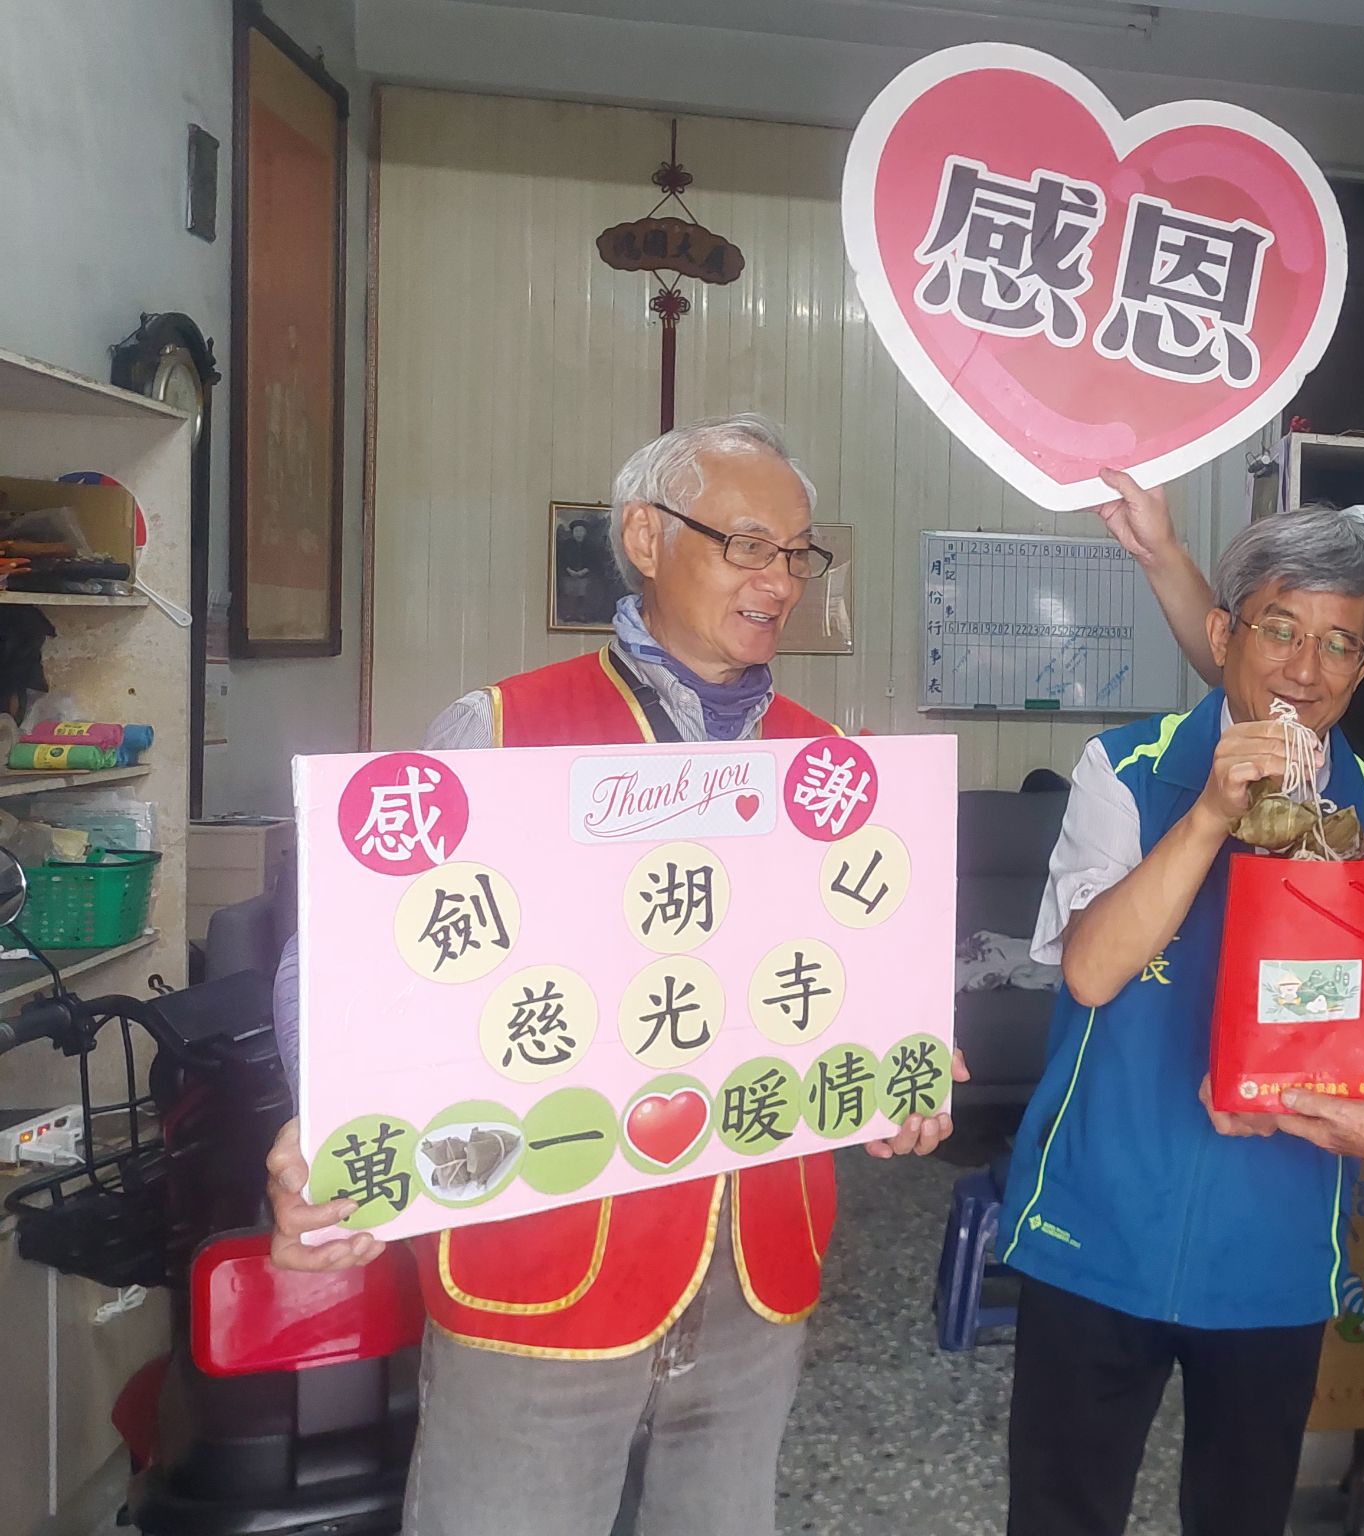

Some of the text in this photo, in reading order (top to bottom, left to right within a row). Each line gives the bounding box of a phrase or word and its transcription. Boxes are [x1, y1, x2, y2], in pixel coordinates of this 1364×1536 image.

[922, 162, 1267, 382] 感恩
[971, 542, 978, 553] 2
[983, 543, 990, 554] 3
[994, 544, 1001, 553] 4
[1007, 544, 1014, 555] 5
[1019, 545, 1026, 556] 6
[1031, 545, 1038, 556] 7
[1043, 546, 1050, 556] 8
[1055, 546, 1062, 556] 9
[1089, 547, 1099, 558] 12
[1101, 547, 1111, 558] 13
[1112, 548, 1122, 559] 14
[354, 766, 446, 864] 感
[592, 759, 750, 826] Thank you
[793, 747, 870, 835] 謝
